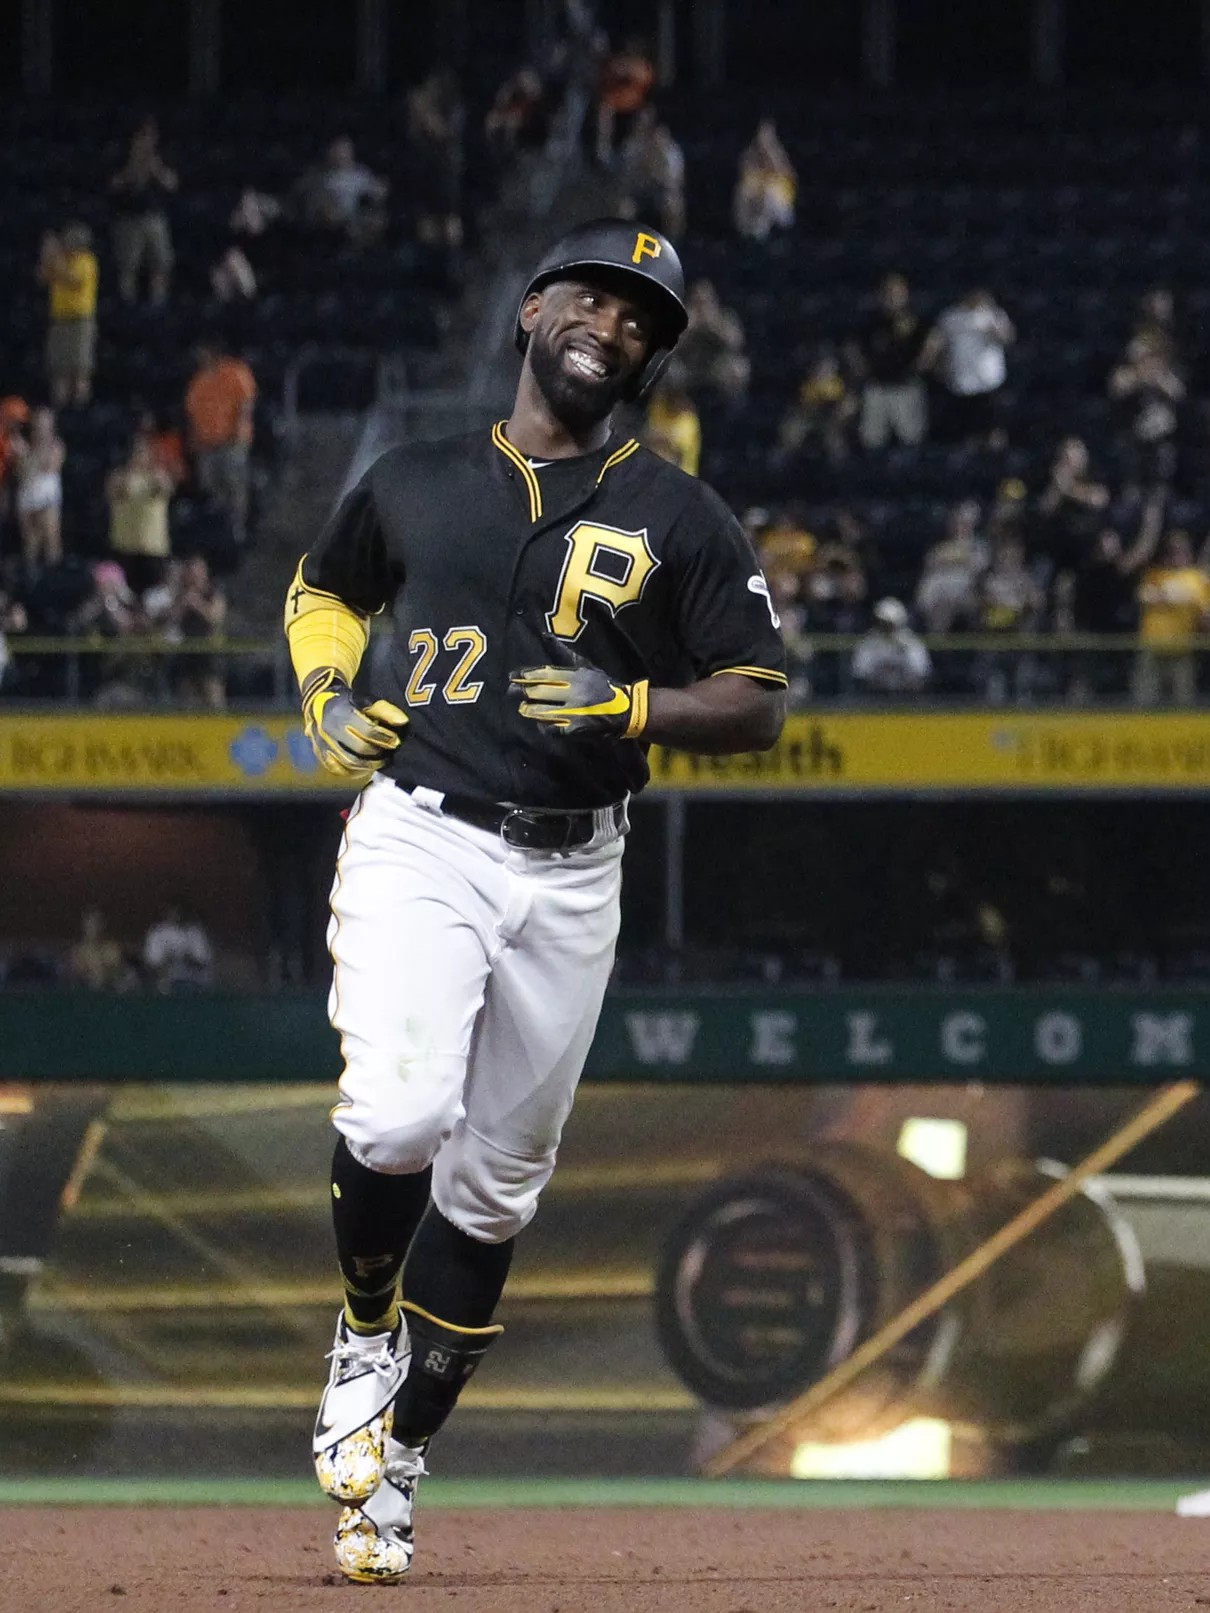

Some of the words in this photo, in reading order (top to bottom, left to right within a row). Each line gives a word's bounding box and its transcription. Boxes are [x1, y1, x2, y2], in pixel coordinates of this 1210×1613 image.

[632, 232, 661, 264] P
[545, 520, 661, 642] P
[405, 625, 487, 707] 22
[423, 1349, 451, 1374] 22
